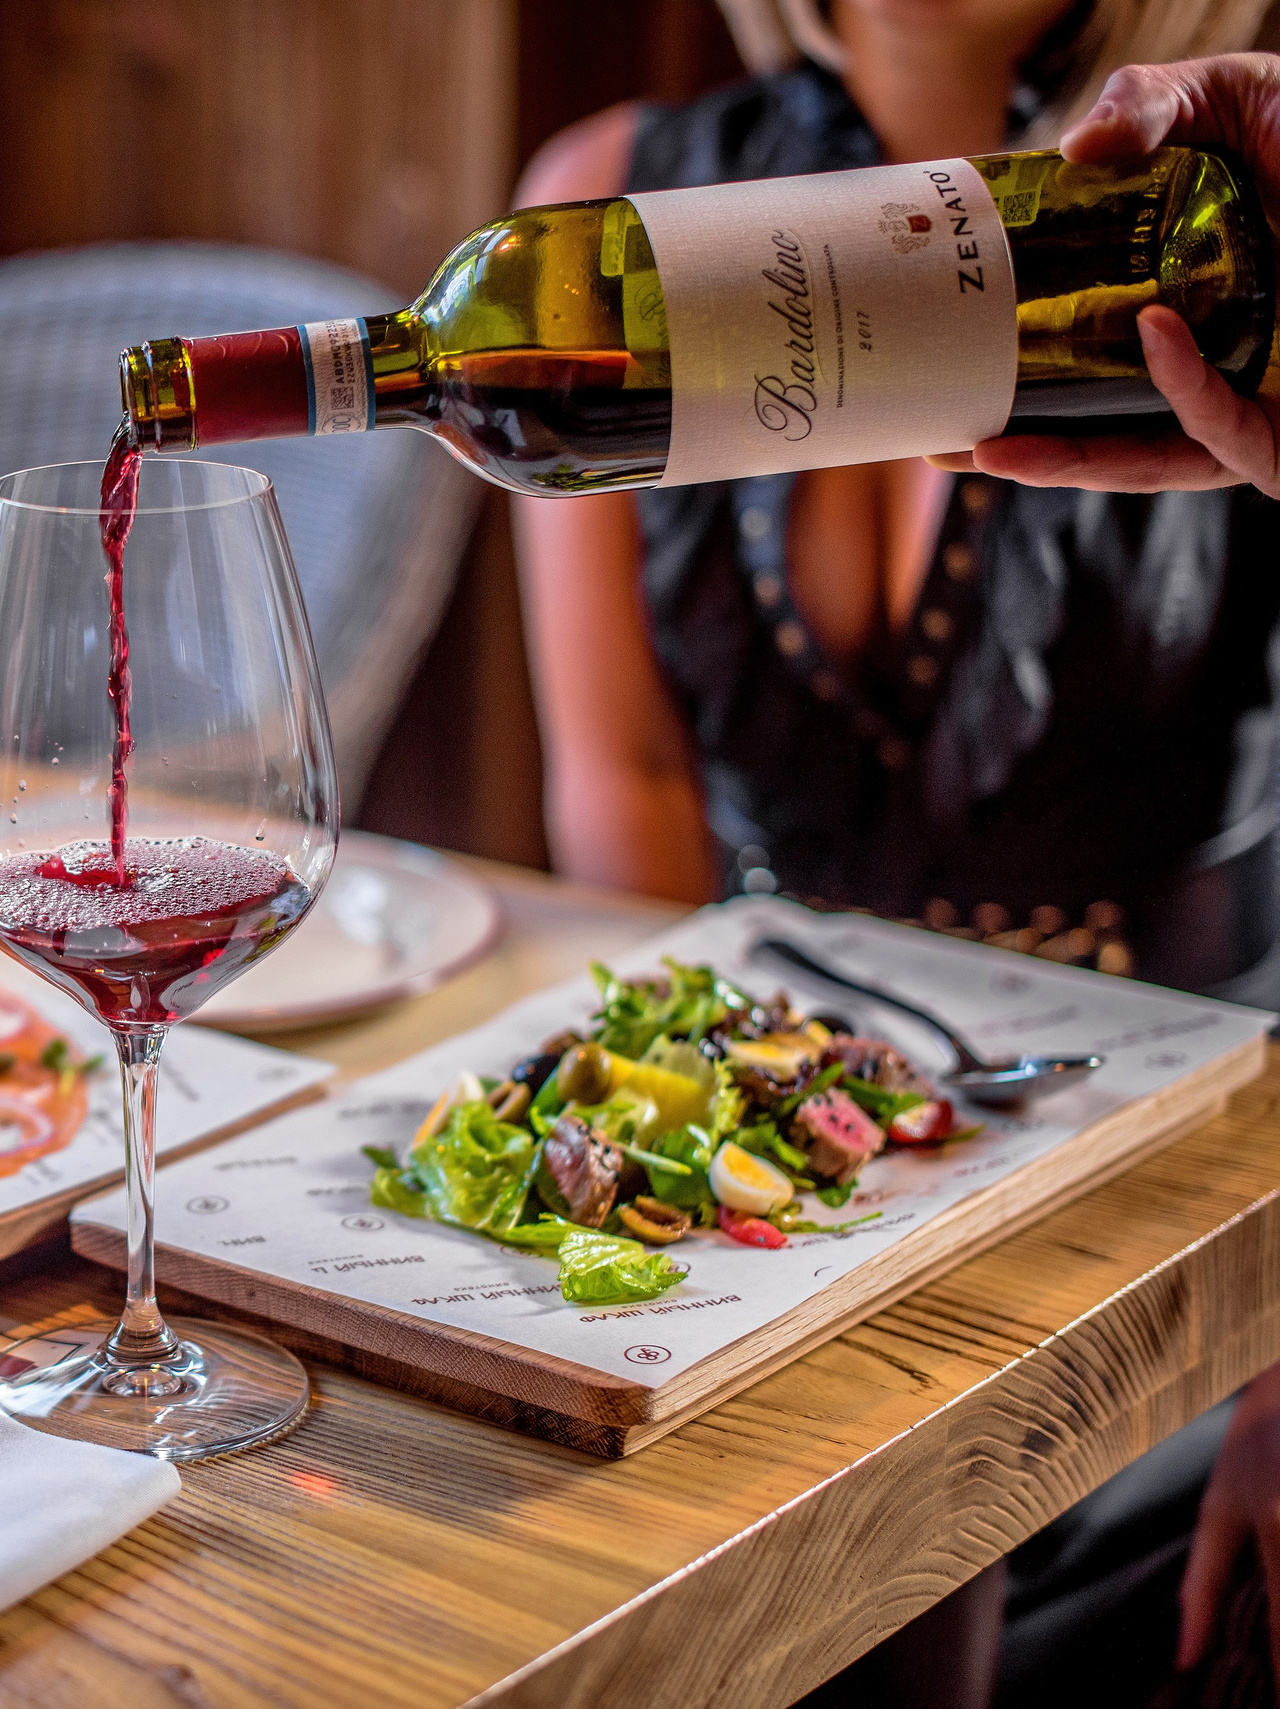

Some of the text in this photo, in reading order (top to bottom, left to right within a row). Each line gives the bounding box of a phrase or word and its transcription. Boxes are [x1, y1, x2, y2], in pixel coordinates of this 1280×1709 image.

[928, 170, 985, 294] ZENATO
[753, 228, 818, 441] Bardolino
[823, 244, 845, 408] DENOMINAZIONE DI ORIGINE CONTROLLATA
[856, 310, 872, 353] 2017
[480, 1283, 563, 1300] ИННЫЙ
[579, 1294, 742, 1323] ВИННЫЙ ШКАФ
